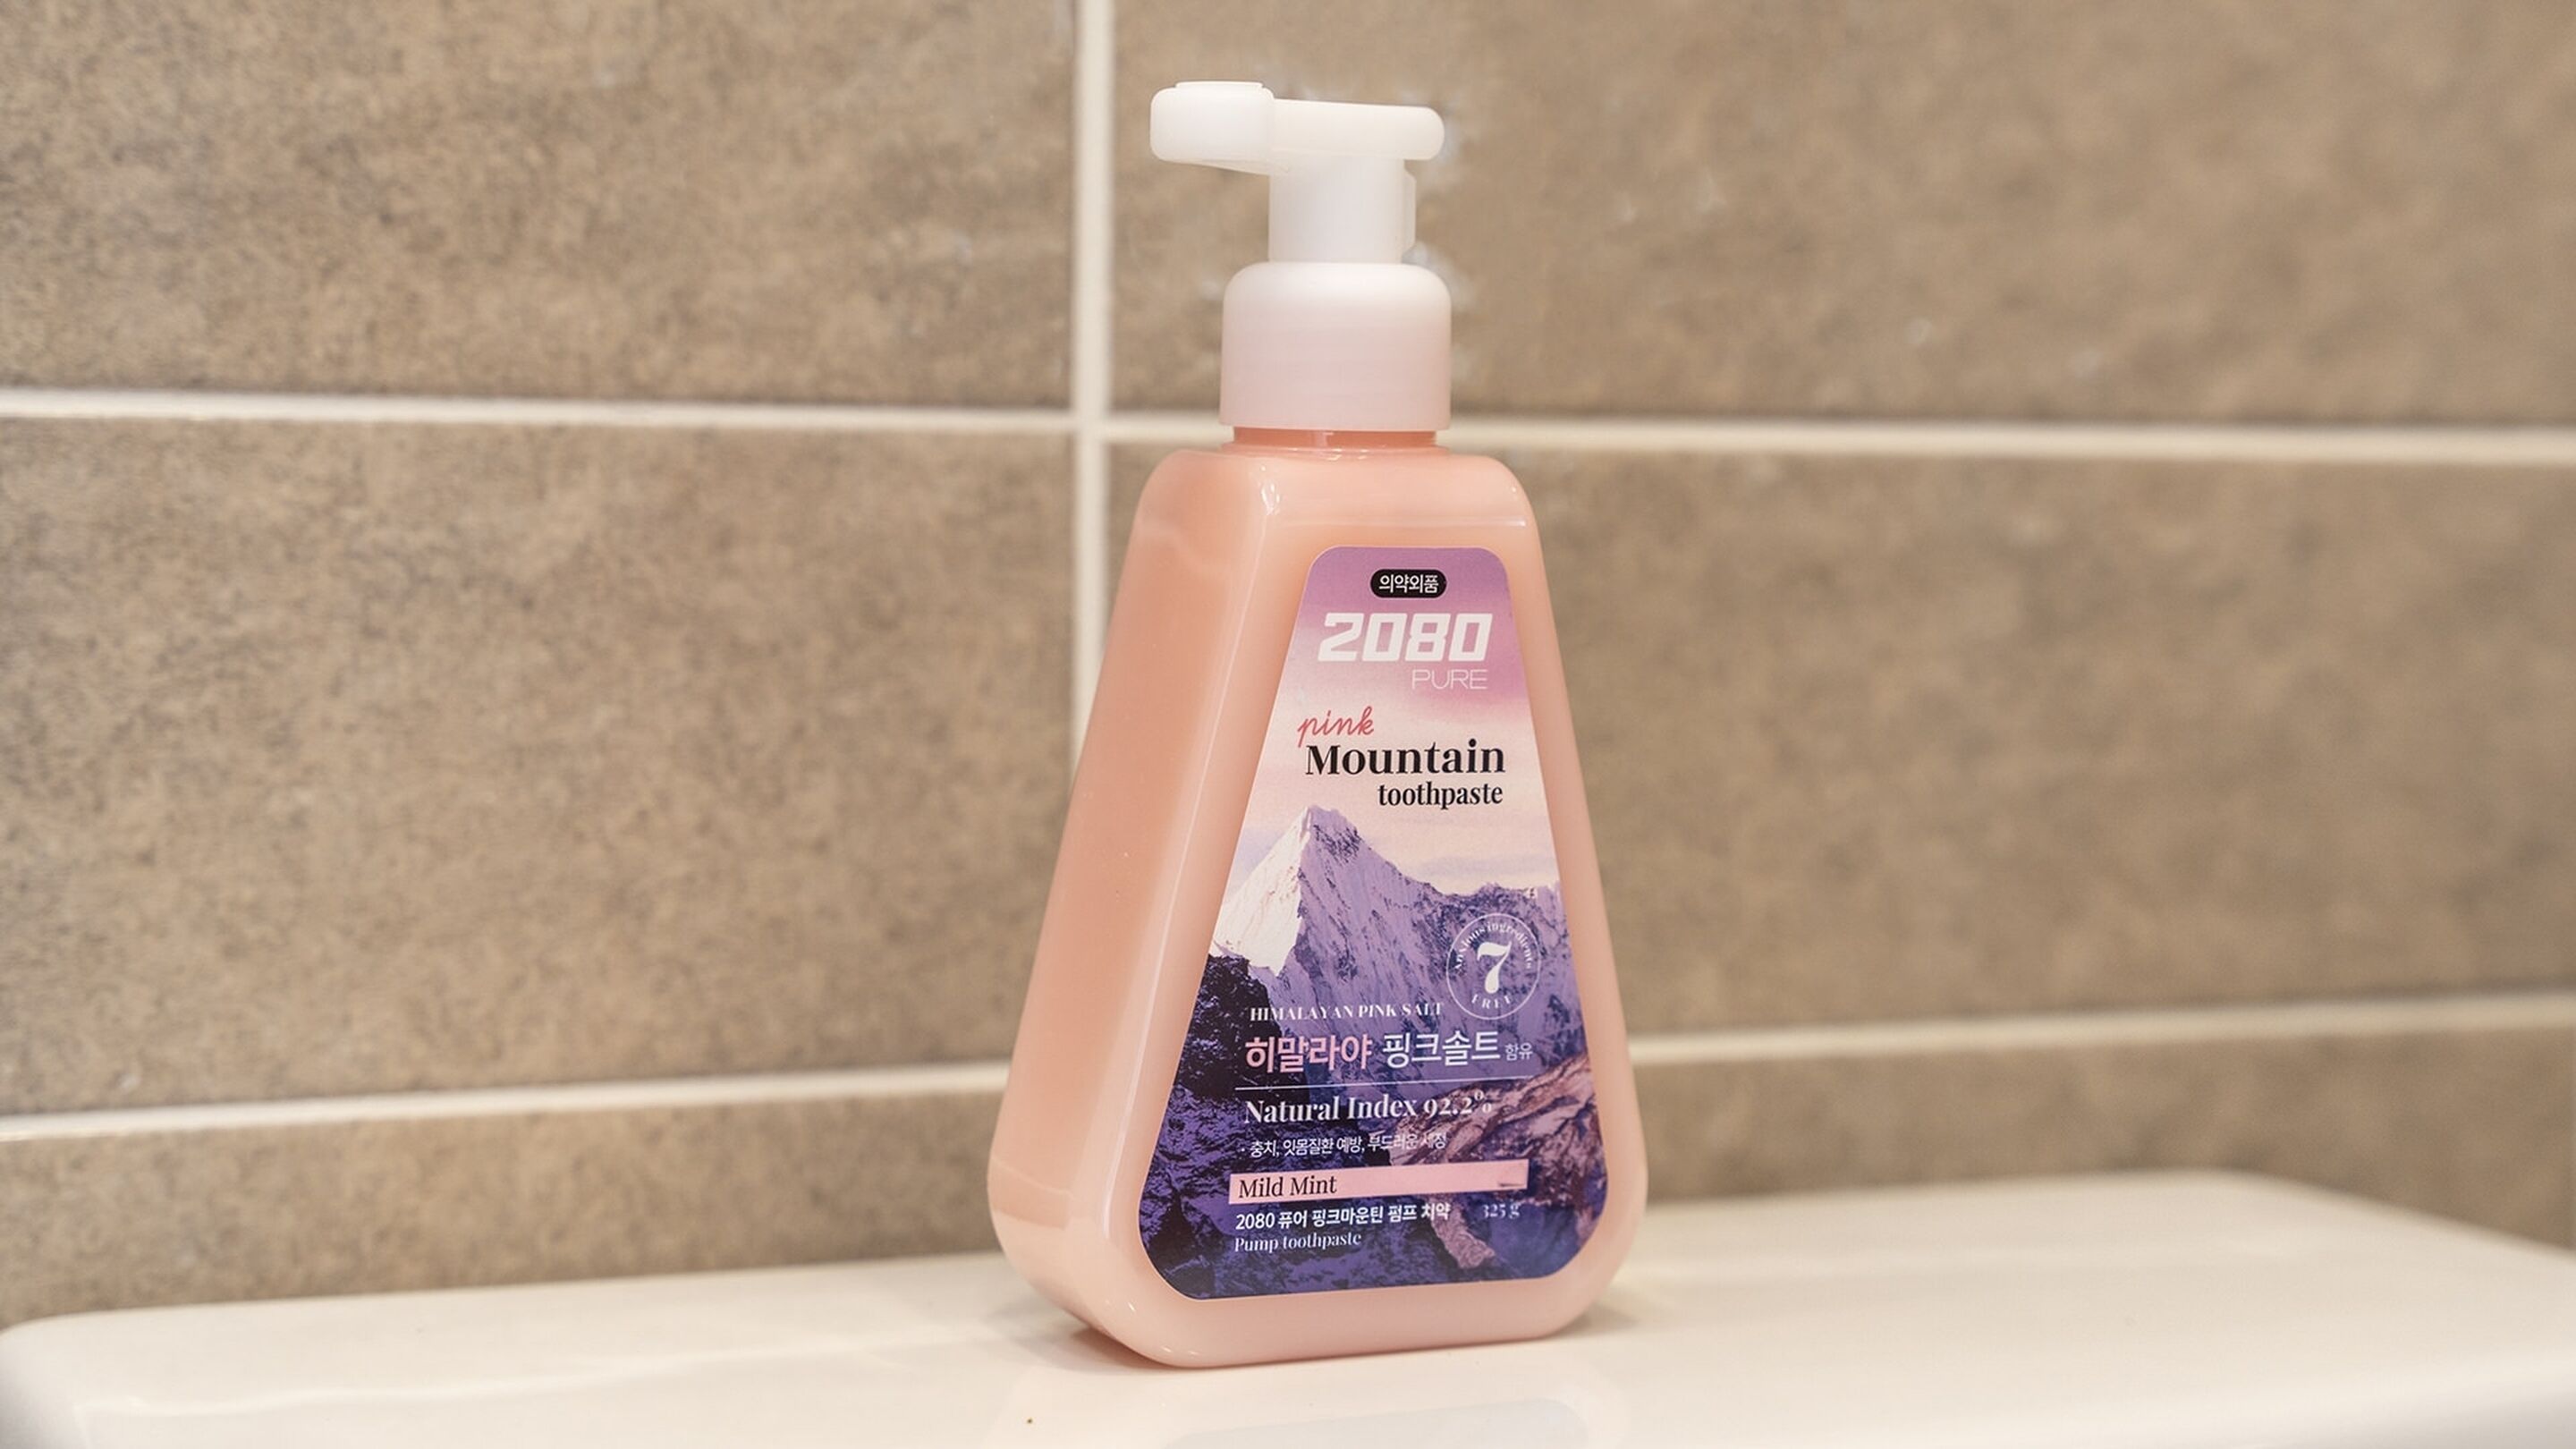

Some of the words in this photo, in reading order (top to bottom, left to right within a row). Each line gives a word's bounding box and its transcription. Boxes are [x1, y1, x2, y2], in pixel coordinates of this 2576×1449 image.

[1377, 573, 1439, 594] 의약외품
[1317, 612, 1494, 662] 2080
[1411, 669, 1488, 690] PURE
[1297, 705, 1375, 749] pink
[1305, 738, 1505, 775] Mountain
[1377, 780, 1504, 809] toothpaste
[1477, 940, 1513, 994] 7
[1250, 1005, 1353, 1021] HIMALAYAN
[1358, 1004, 1396, 1018] PINK
[1401, 1002, 1445, 1016] SALT
[1244, 1033, 1373, 1073] 히말라야
[1382, 1030, 1501, 1069] 핑크솔트
[1504, 1043, 1533, 1061] 함유
[1244, 1095, 1340, 1123] Natural
[1347, 1094, 1419, 1119] Index
[1250, 1140, 1281, 1158] 충치,
[1283, 1137, 1335, 1157] 잇몸질환
[1336, 1135, 1366, 1154] 예방,
[1368, 1133, 1419, 1151] 부드러운
[1239, 1176, 1284, 1199] Mild
[1290, 1174, 1337, 1196] Mint
[1235, 1213, 1275, 1230] 2080
[1278, 1210, 1309, 1229] 퓨어
[1311, 1206, 1385, 1225] 핑크마운틴
[1387, 1204, 1418, 1223] 펌프
[1420, 1202, 1451, 1221] 치약
[1483, 1203, 1506, 1218] 325
[1234, 1235, 1279, 1253] Pump
[1282, 1232, 1362, 1250] toothpaste
